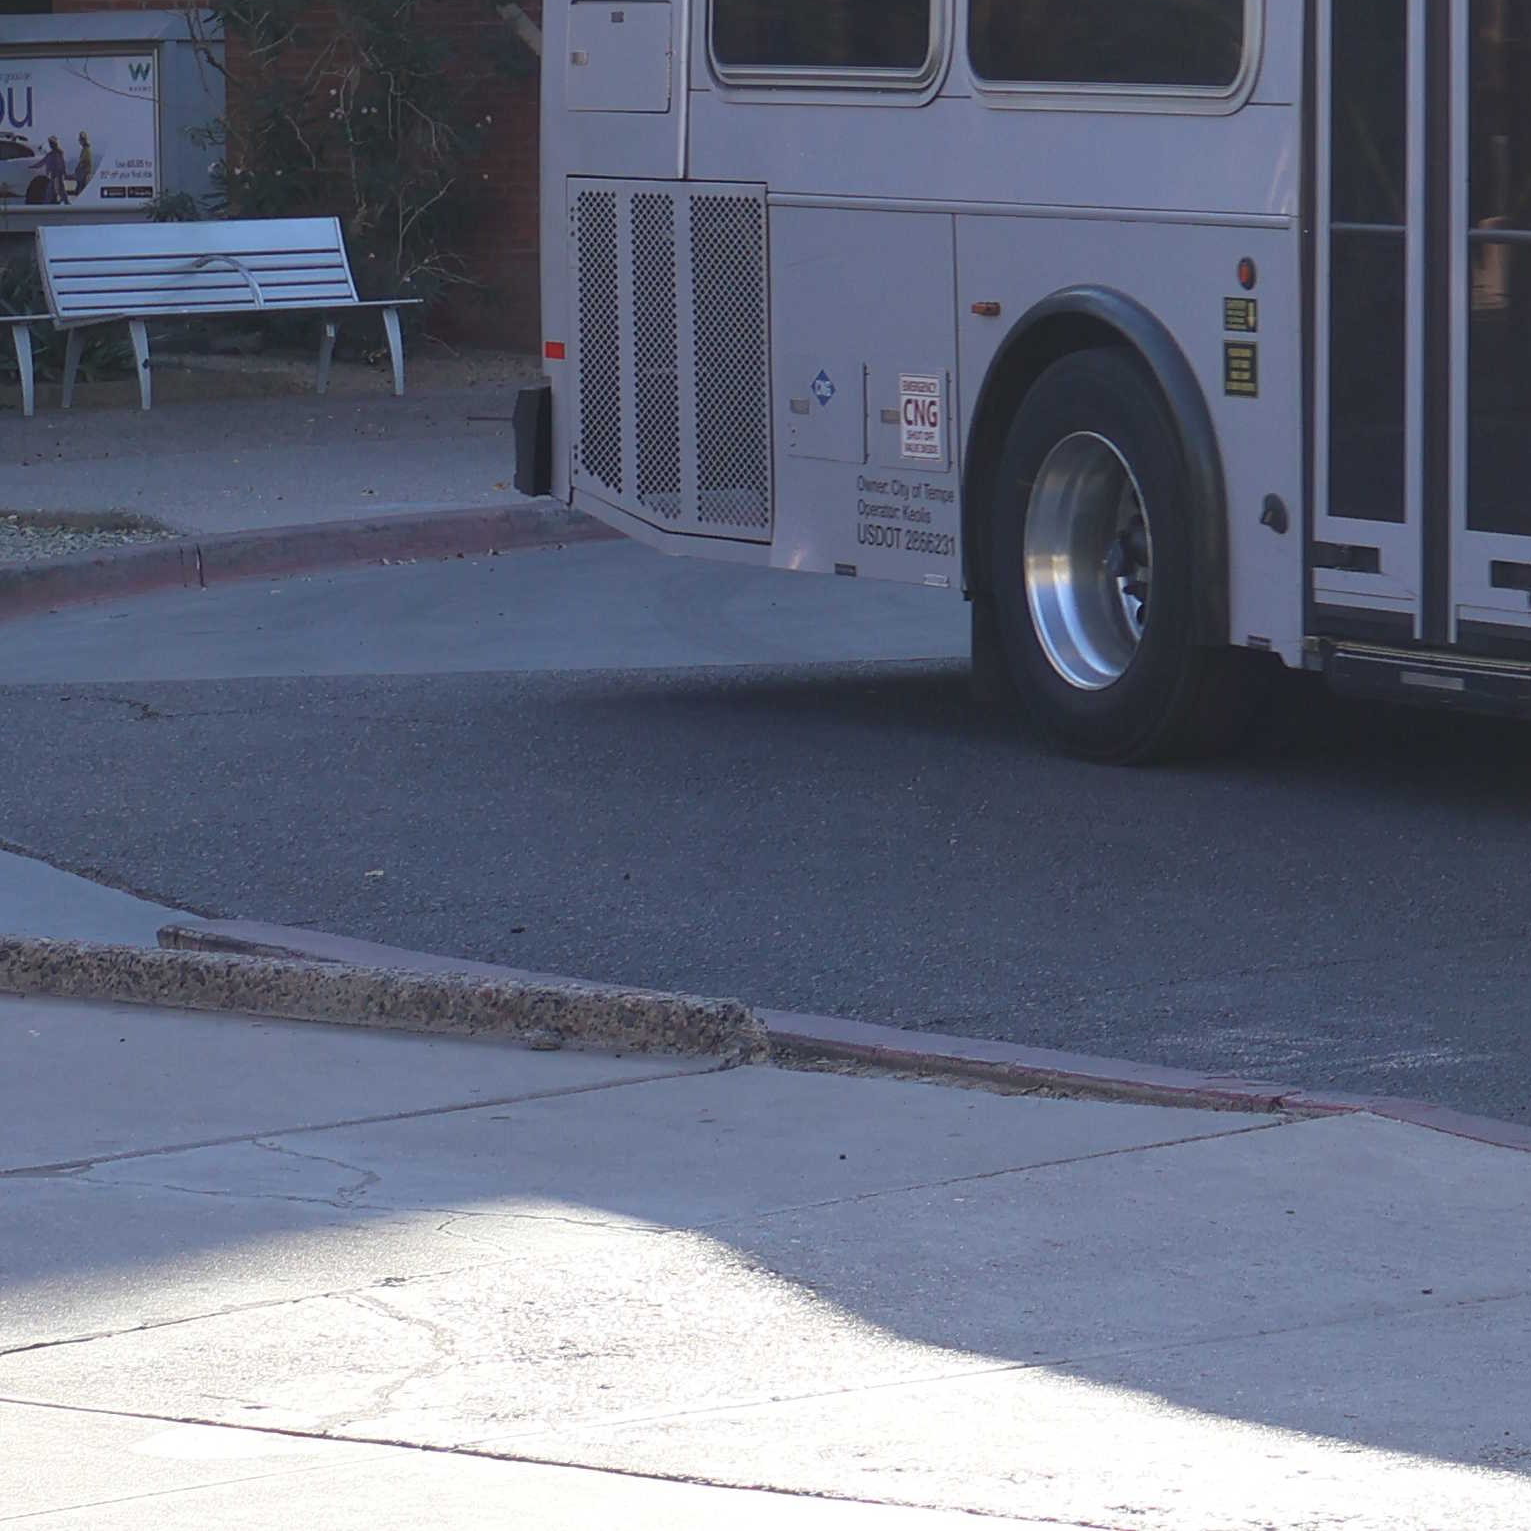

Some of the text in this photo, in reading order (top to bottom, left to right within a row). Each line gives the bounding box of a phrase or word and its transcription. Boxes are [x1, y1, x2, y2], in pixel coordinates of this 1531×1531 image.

[904, 398, 938, 428] CNG
[857, 475, 955, 503] Owner: City of Tempe
[857, 523, 902, 549] USDOT
